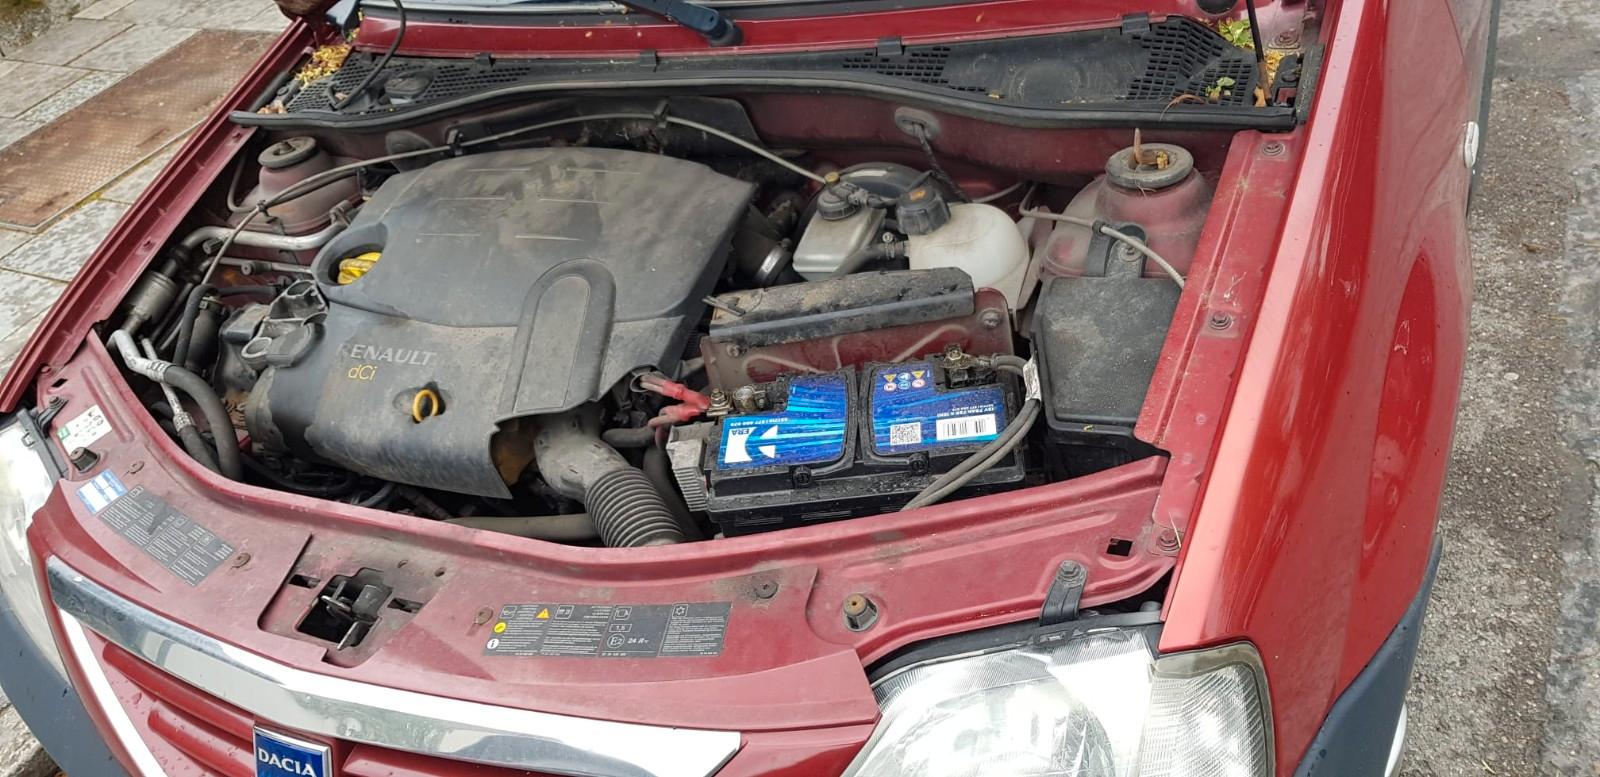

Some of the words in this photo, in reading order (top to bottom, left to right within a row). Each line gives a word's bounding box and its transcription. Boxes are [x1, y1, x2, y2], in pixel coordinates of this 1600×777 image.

[347, 364, 378, 381] dCi
[731, 428, 750, 436] ERA
[257, 747, 317, 777] DACIA
